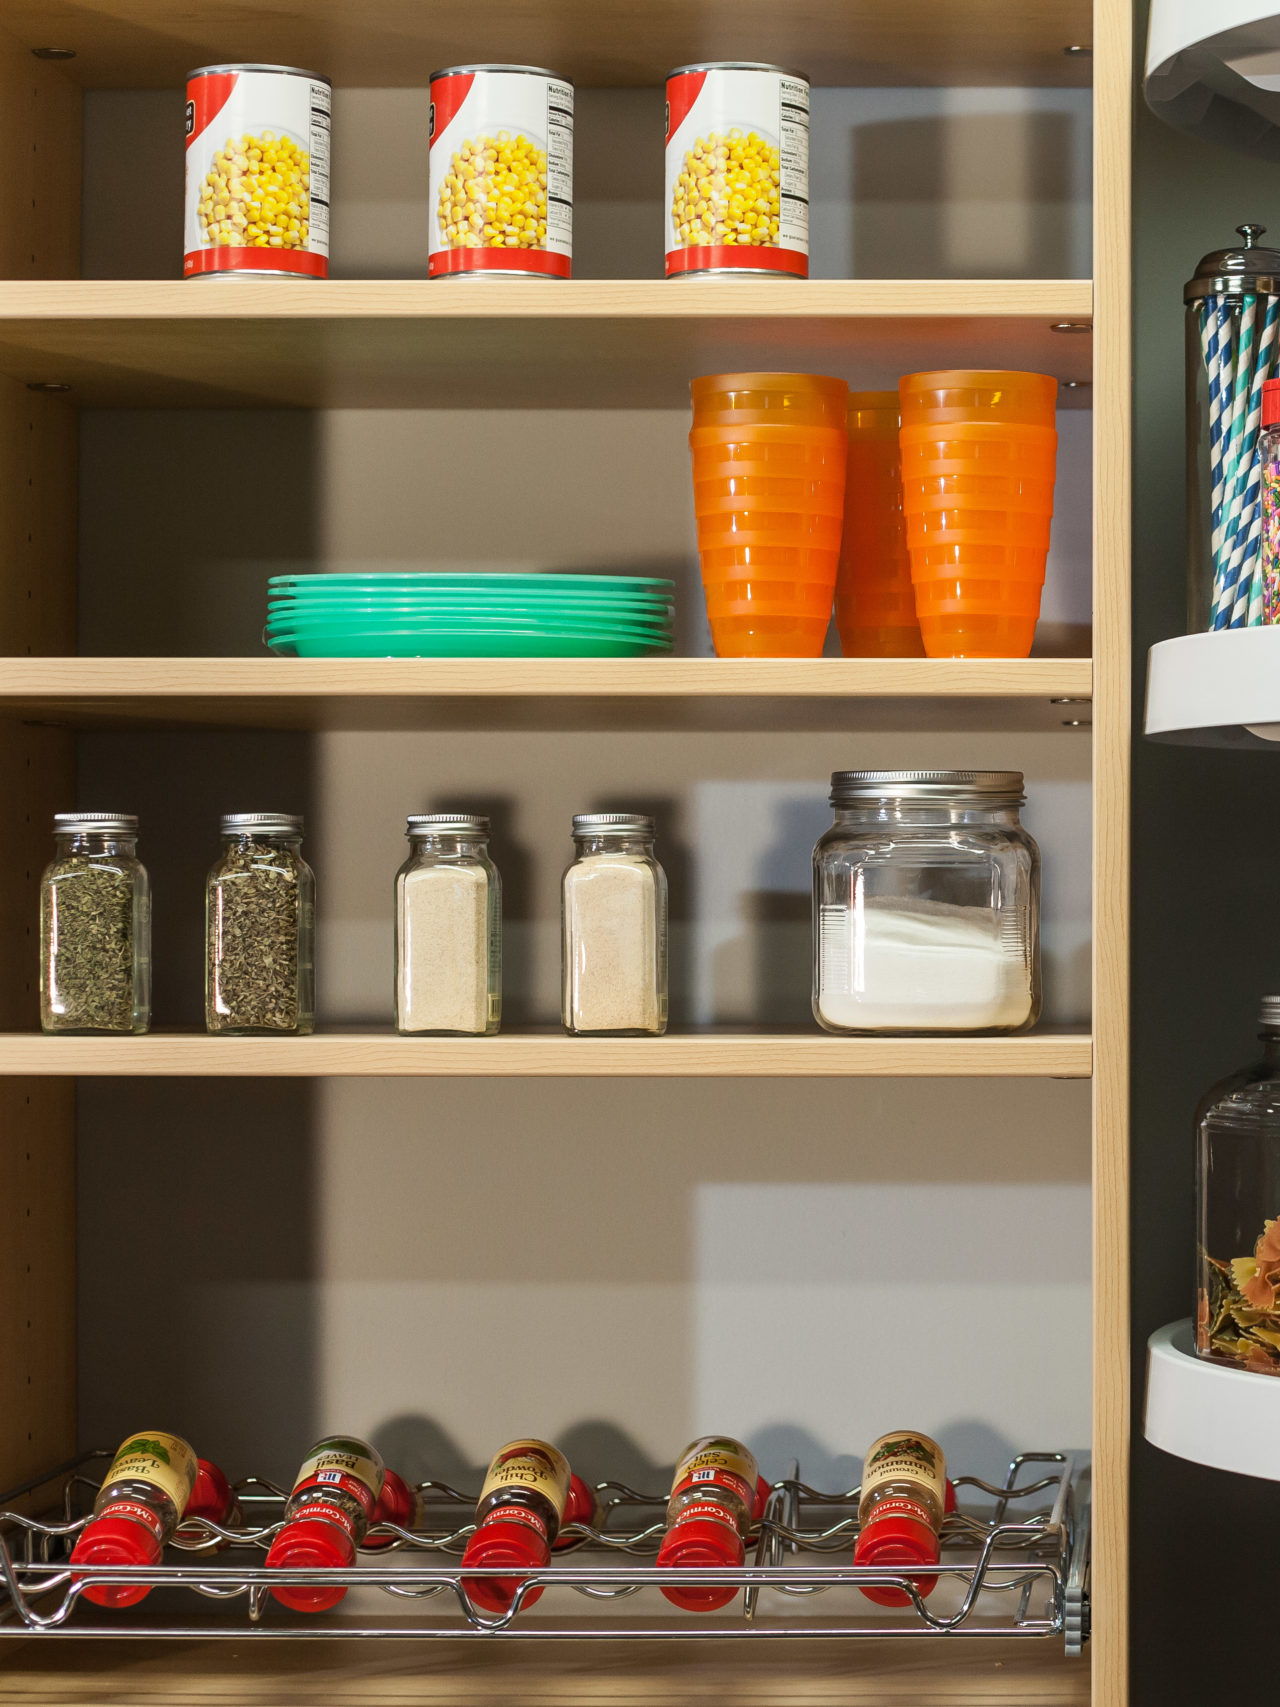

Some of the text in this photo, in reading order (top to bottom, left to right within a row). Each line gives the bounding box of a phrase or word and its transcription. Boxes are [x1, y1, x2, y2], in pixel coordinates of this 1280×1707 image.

[549, 85, 569, 97] Nutrition
[781, 82, 803, 93] Nutrition
[317, 1454, 359, 1462] LEAVES
[694, 1451, 720, 1462] Salt
[316, 1459, 356, 1470] Basil
[687, 1458, 727, 1473] Celery
[865, 1460, 936, 1480] Cinnamon
[111, 1465, 150, 1479] Basil
[493, 1466, 547, 1480] Powder
[500, 1473, 537, 1483] Chili
[879, 1468, 918, 1477] Ground
[295, 1507, 352, 1532] McCormick
[676, 1506, 736, 1529] McCormick
